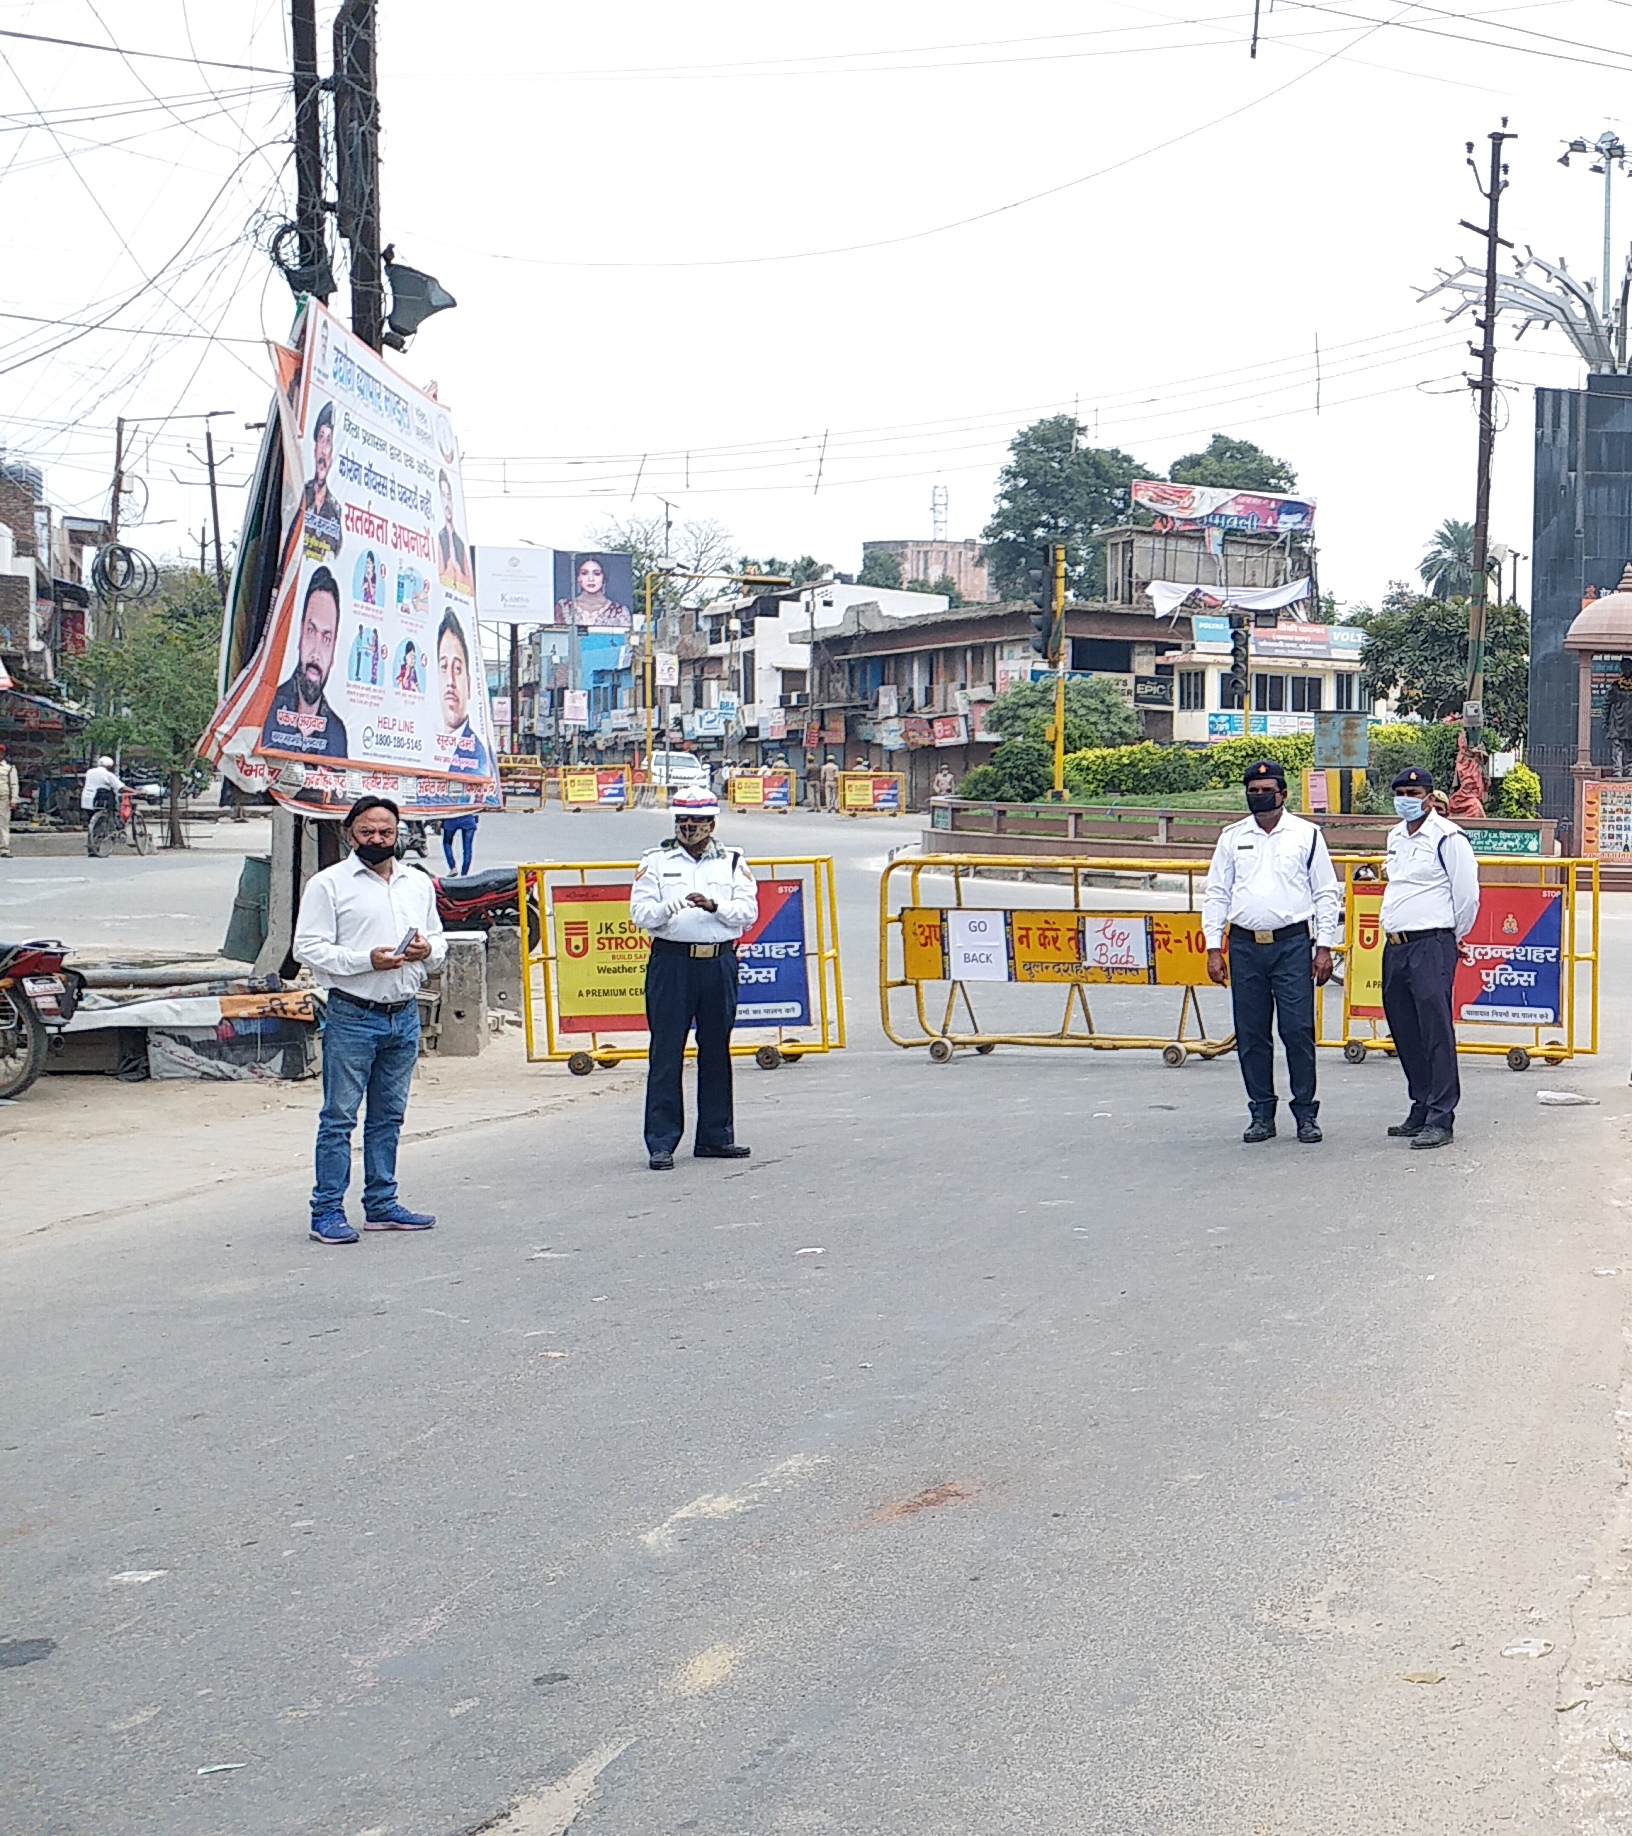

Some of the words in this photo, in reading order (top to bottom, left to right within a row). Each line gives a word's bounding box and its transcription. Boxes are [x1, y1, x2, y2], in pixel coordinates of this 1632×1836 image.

[339, 448, 362, 486] कोरोना
[344, 500, 388, 545] सतर्कता
[1136, 683, 1167, 695] EPIC
[378, 716, 397, 733] HELP
[398, 719, 415, 734] LINE
[375, 733, 423, 751] 1800-180-5145
[436, 734, 457, 751] सूरज
[458, 734, 475, 751] वर्मा
[777, 885, 799, 894] STOP
[1541, 890, 1561, 899] STOP
[596, 922, 614, 935] JK
[968, 921, 988, 932] GO
[1018, 927, 1033, 949] न
[1037, 919, 1062, 952] करें
[963, 953, 992, 963] BACK
[1093, 943, 1139, 966] Back
[596, 964, 637, 975] Weather
[1480, 965, 1536, 993] पुलिस
[578, 989, 584, 998] A
[586, 988, 627, 998] PREMIUM
[1465, 1009, 1490, 1017] यातायात
[1521, 1011, 1537, 1019] पालन
